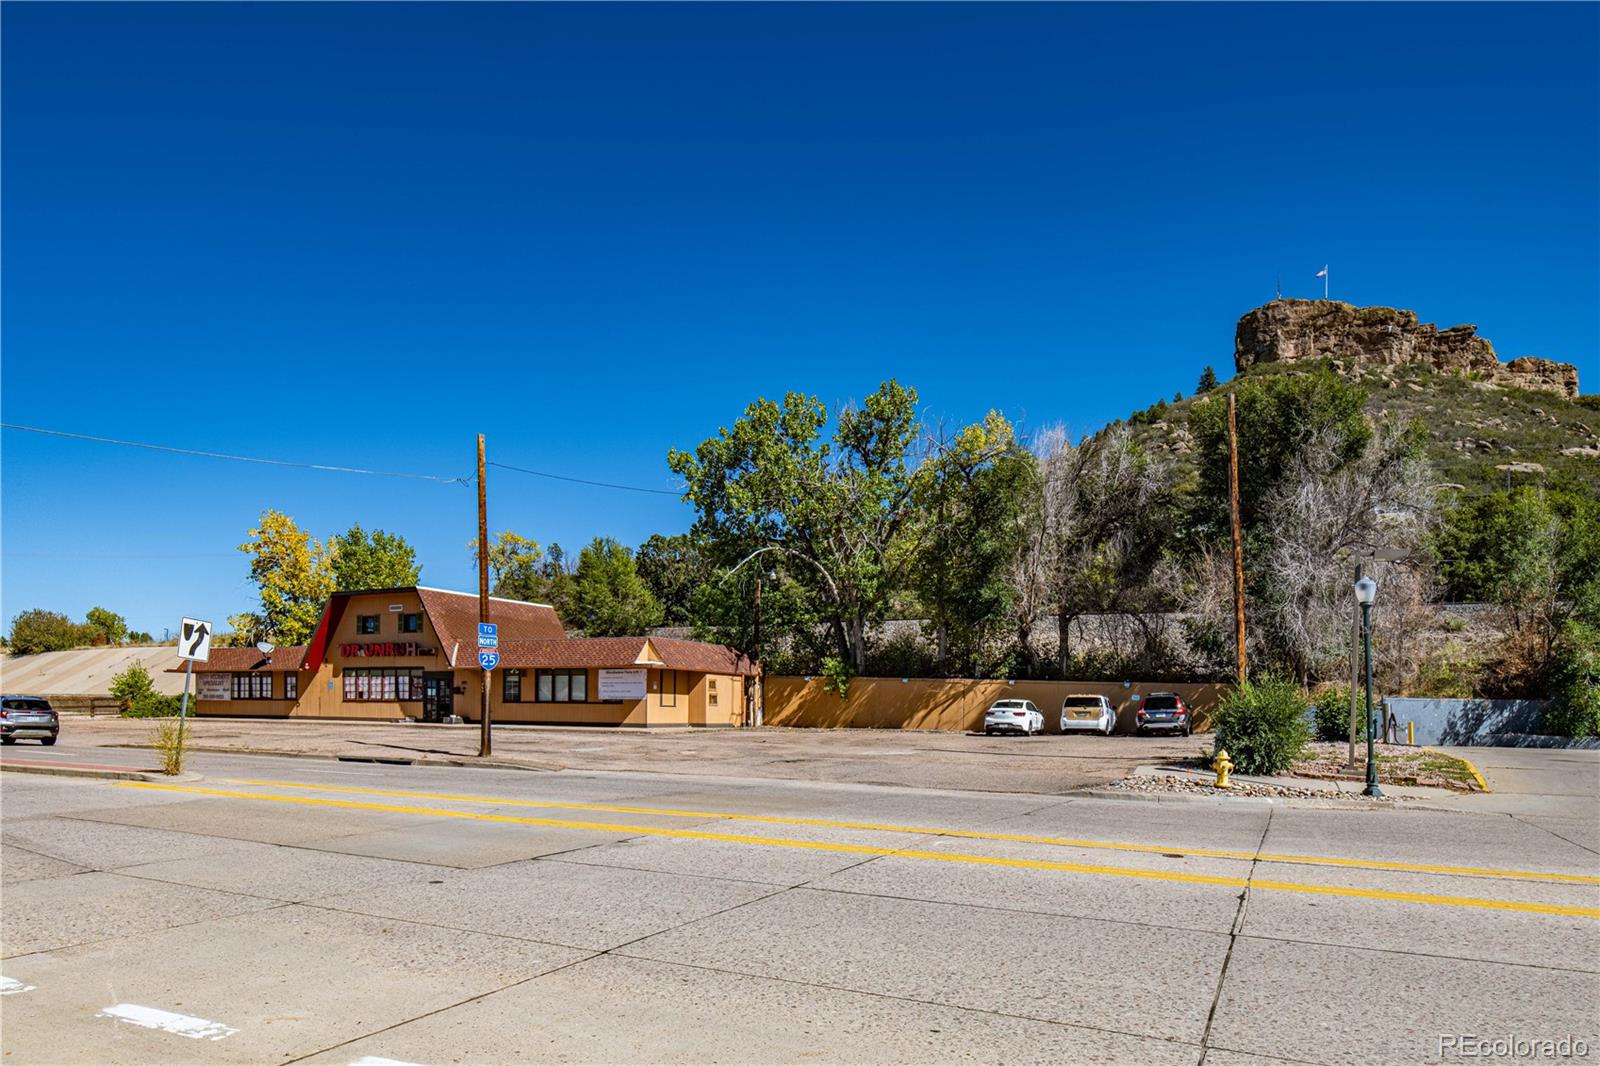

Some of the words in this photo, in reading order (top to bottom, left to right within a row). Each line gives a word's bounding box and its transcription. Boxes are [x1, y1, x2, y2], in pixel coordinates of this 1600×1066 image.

[483, 625, 493, 633] TO
[479, 637, 497, 645] NORTH
[363, 641, 416, 657] UNRUH
[482, 654, 497, 666] 25
